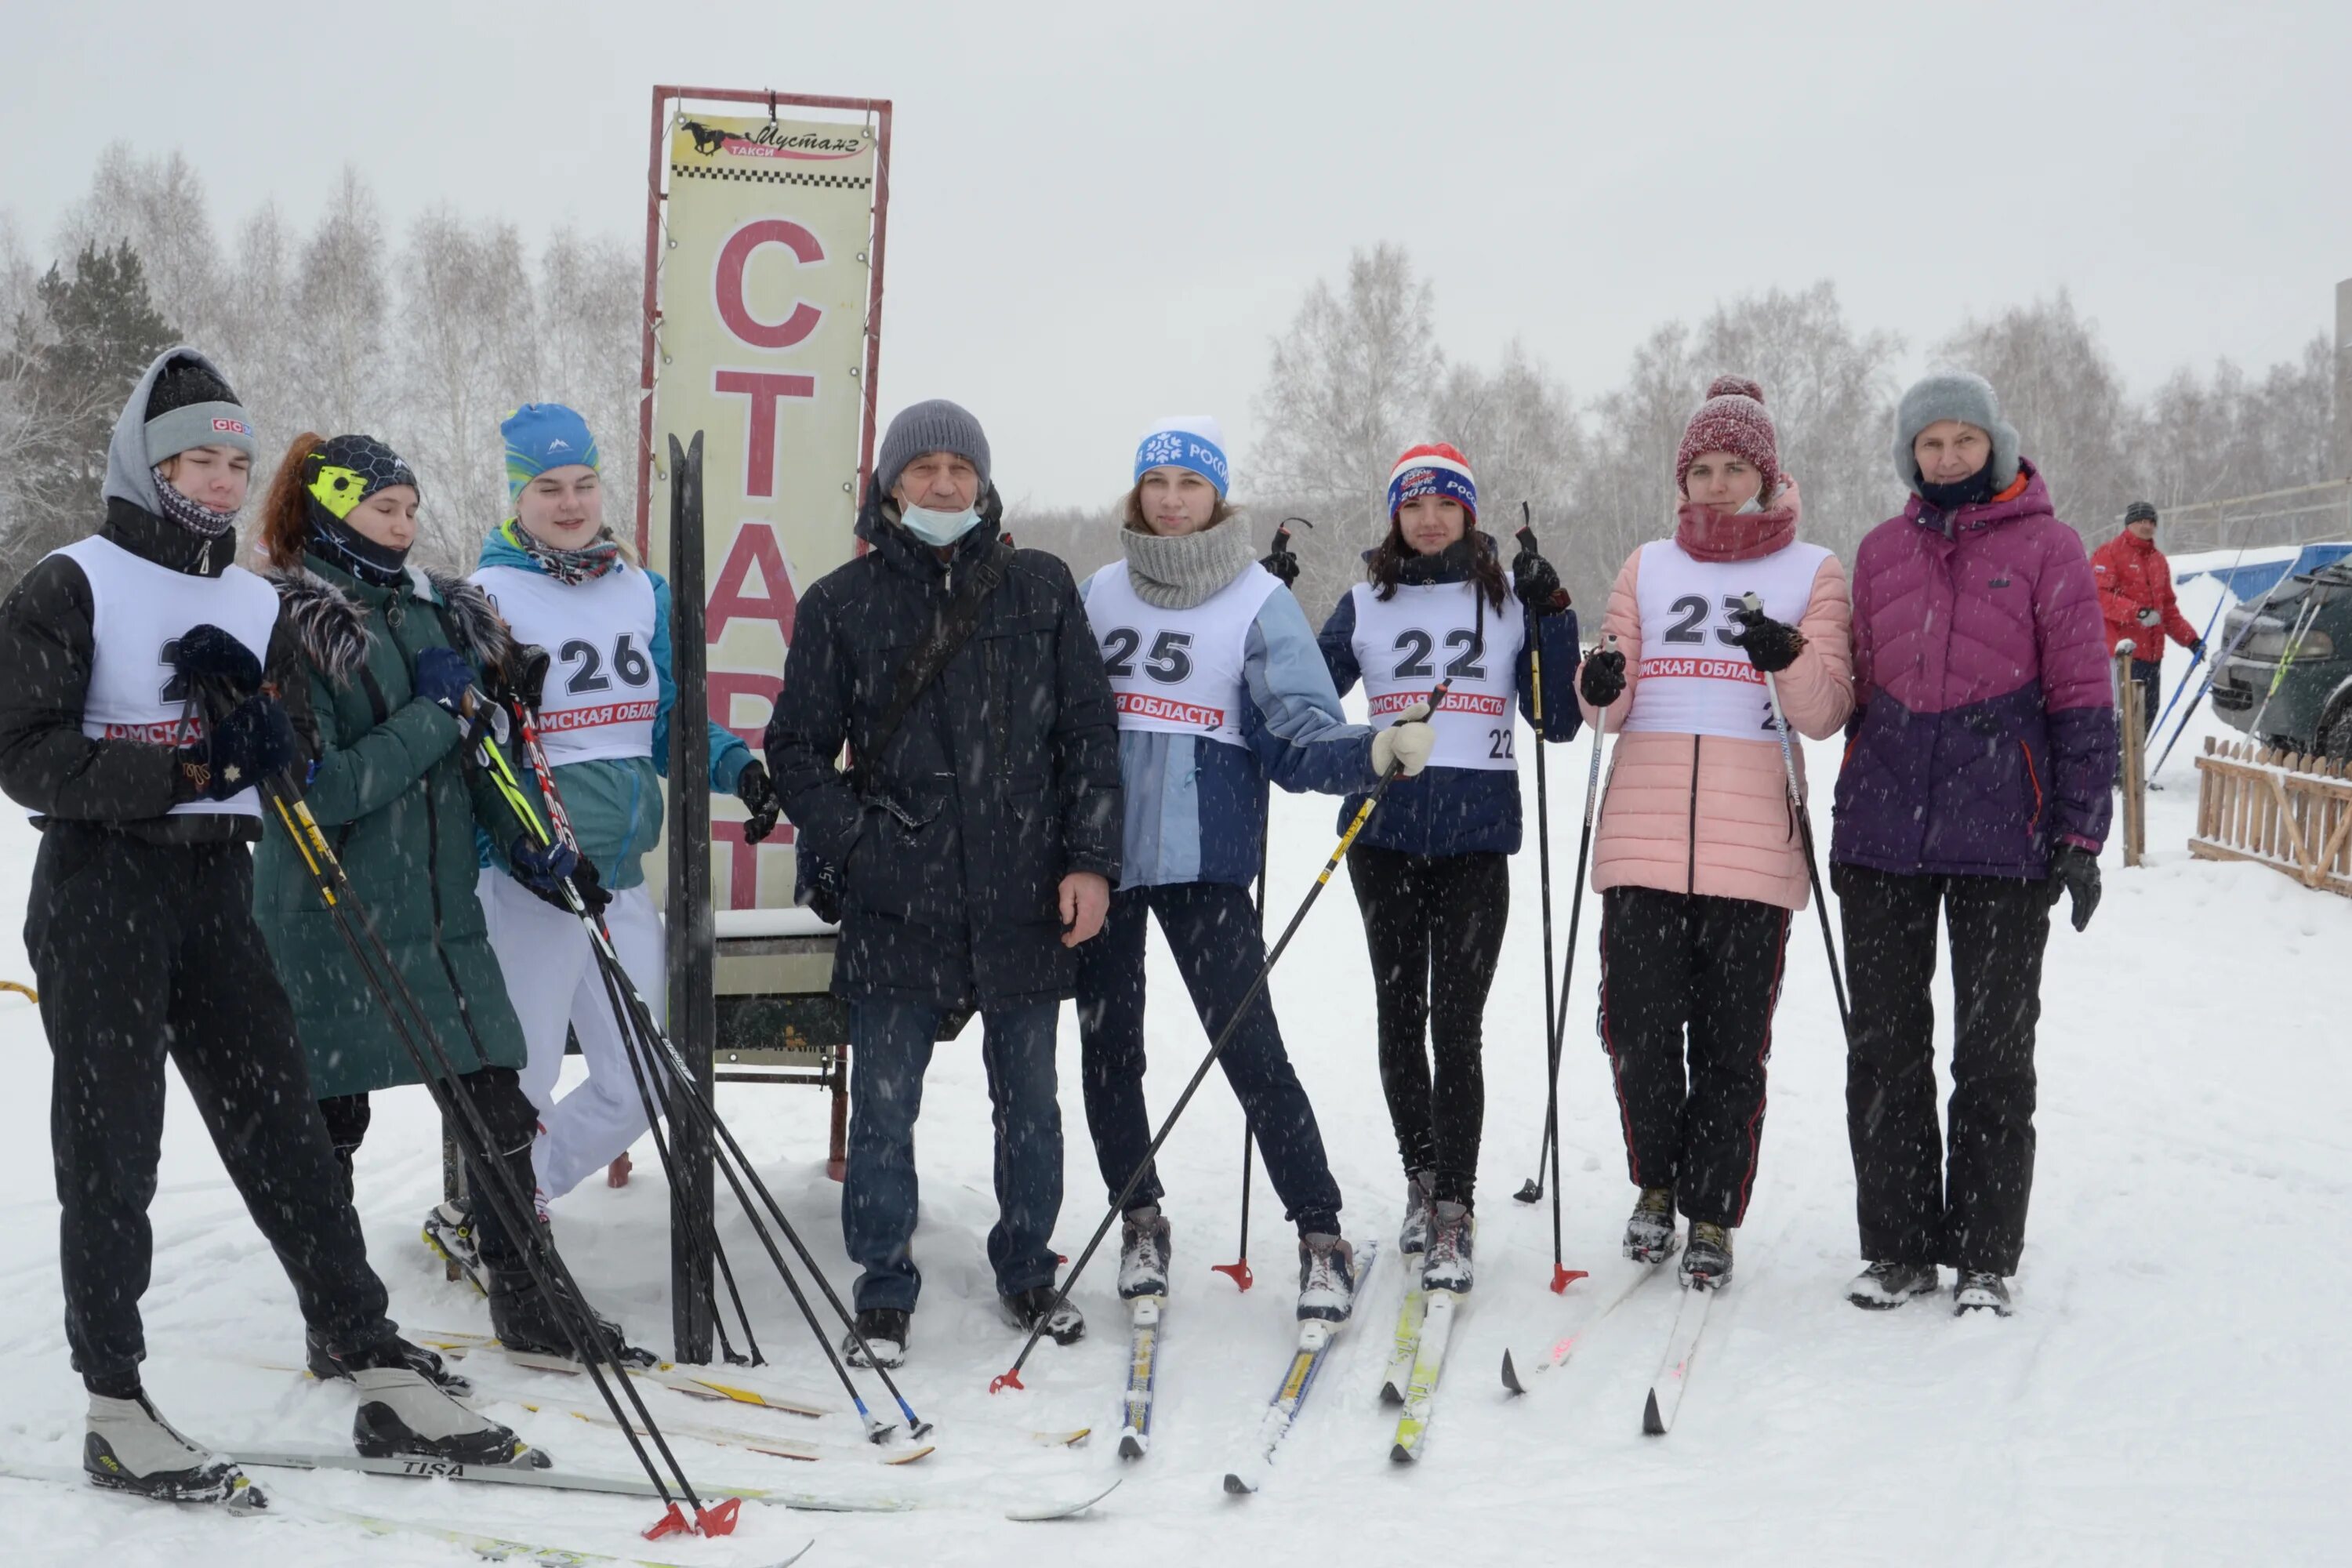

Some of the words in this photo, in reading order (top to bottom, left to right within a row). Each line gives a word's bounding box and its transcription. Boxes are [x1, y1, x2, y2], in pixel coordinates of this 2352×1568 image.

[731, 146, 774, 157] ТАКСИ
[745, 125, 859, 152] Мустанг
[706, 220, 825, 910] СТАРТ
[558, 632, 651, 696] 26
[1102, 626, 1194, 685] 25
[1392, 628, 1487, 681] 22
[1130, 696, 1220, 726] ОБЛАСТЬ
[1489, 729, 1514, 759] 22
[403, 1461, 463, 1476] TISA
